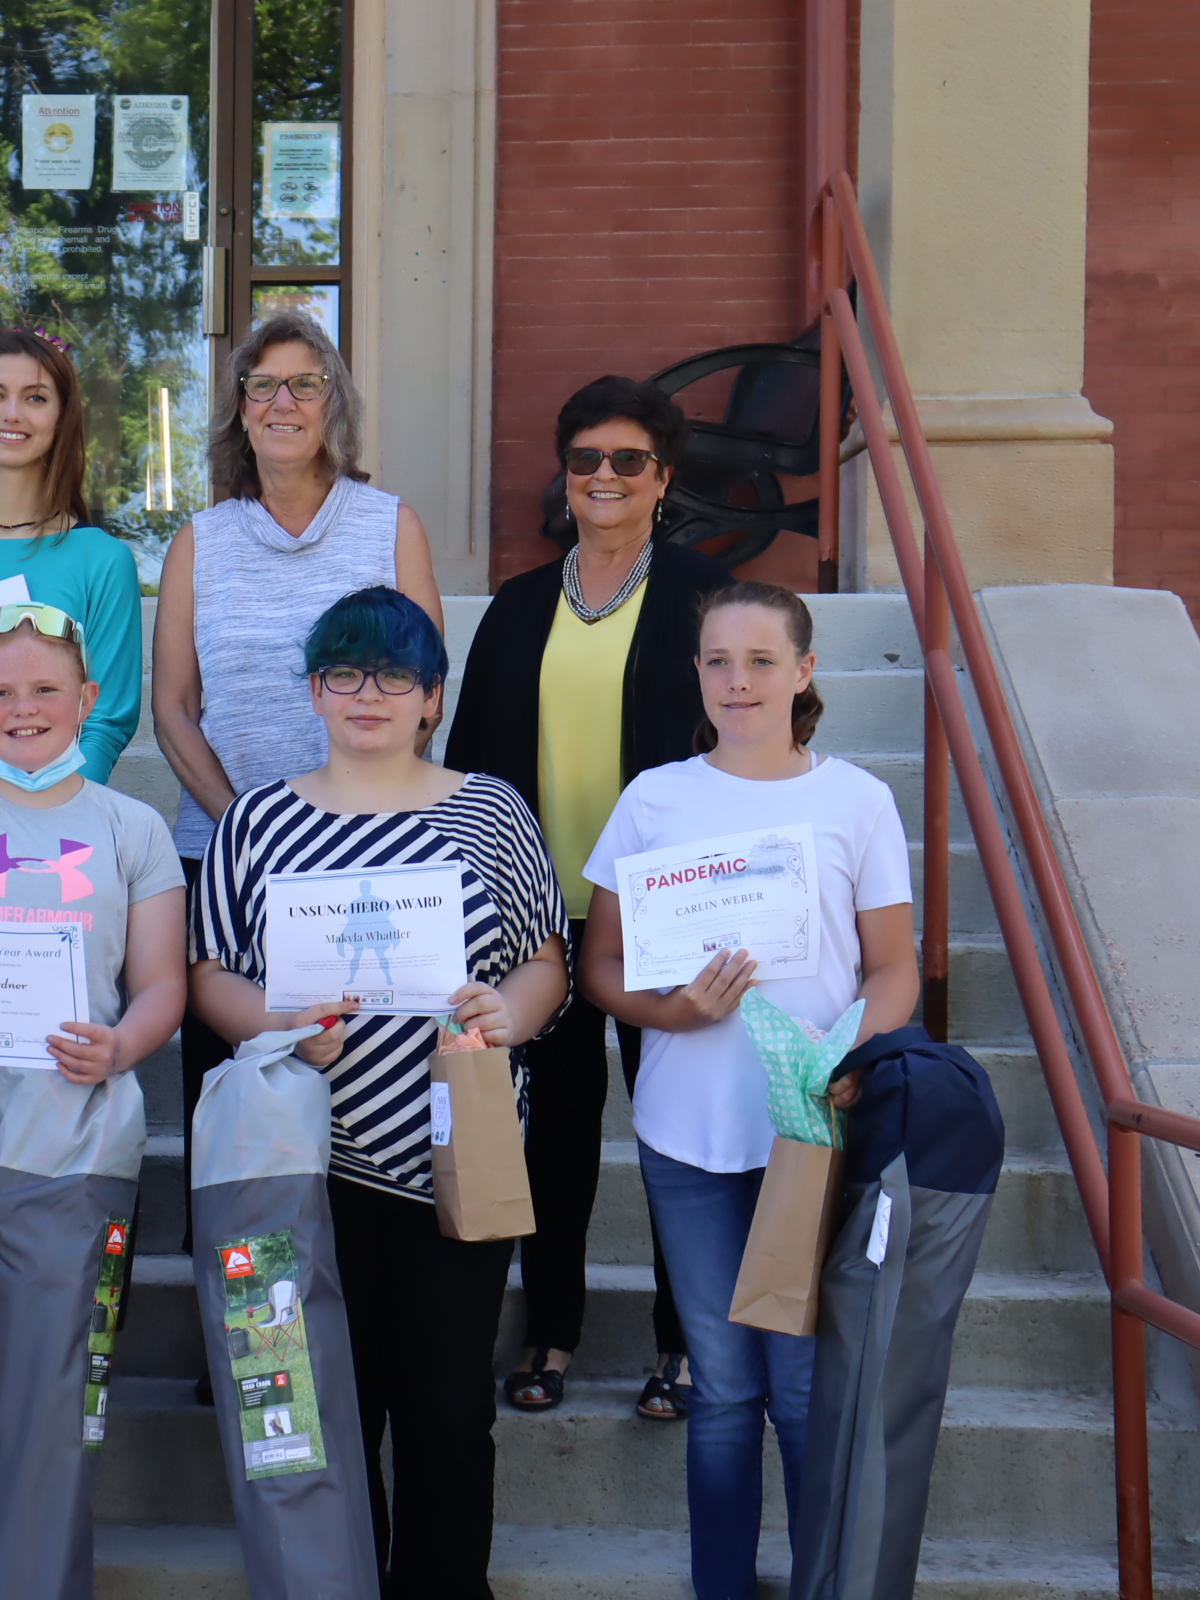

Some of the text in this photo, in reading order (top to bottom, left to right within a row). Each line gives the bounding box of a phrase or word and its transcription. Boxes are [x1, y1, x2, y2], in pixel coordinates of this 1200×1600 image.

[38, 106, 80, 115] Attention
[129, 202, 182, 212] CAUTION
[188, 194, 196, 222] PULL
[62, 245, 103, 254] prohibited.
[62, 273, 88, 281] except
[646, 858, 748, 891] PANDEMIC
[289, 896, 442, 918] UNSUNG HERO AWARD
[675, 892, 764, 916] CARLIN WEBER
[26, 908, 94, 932] ARMOUR
[325, 929, 411, 945] Makyla Whattler
[25, 949, 61, 958] Award
